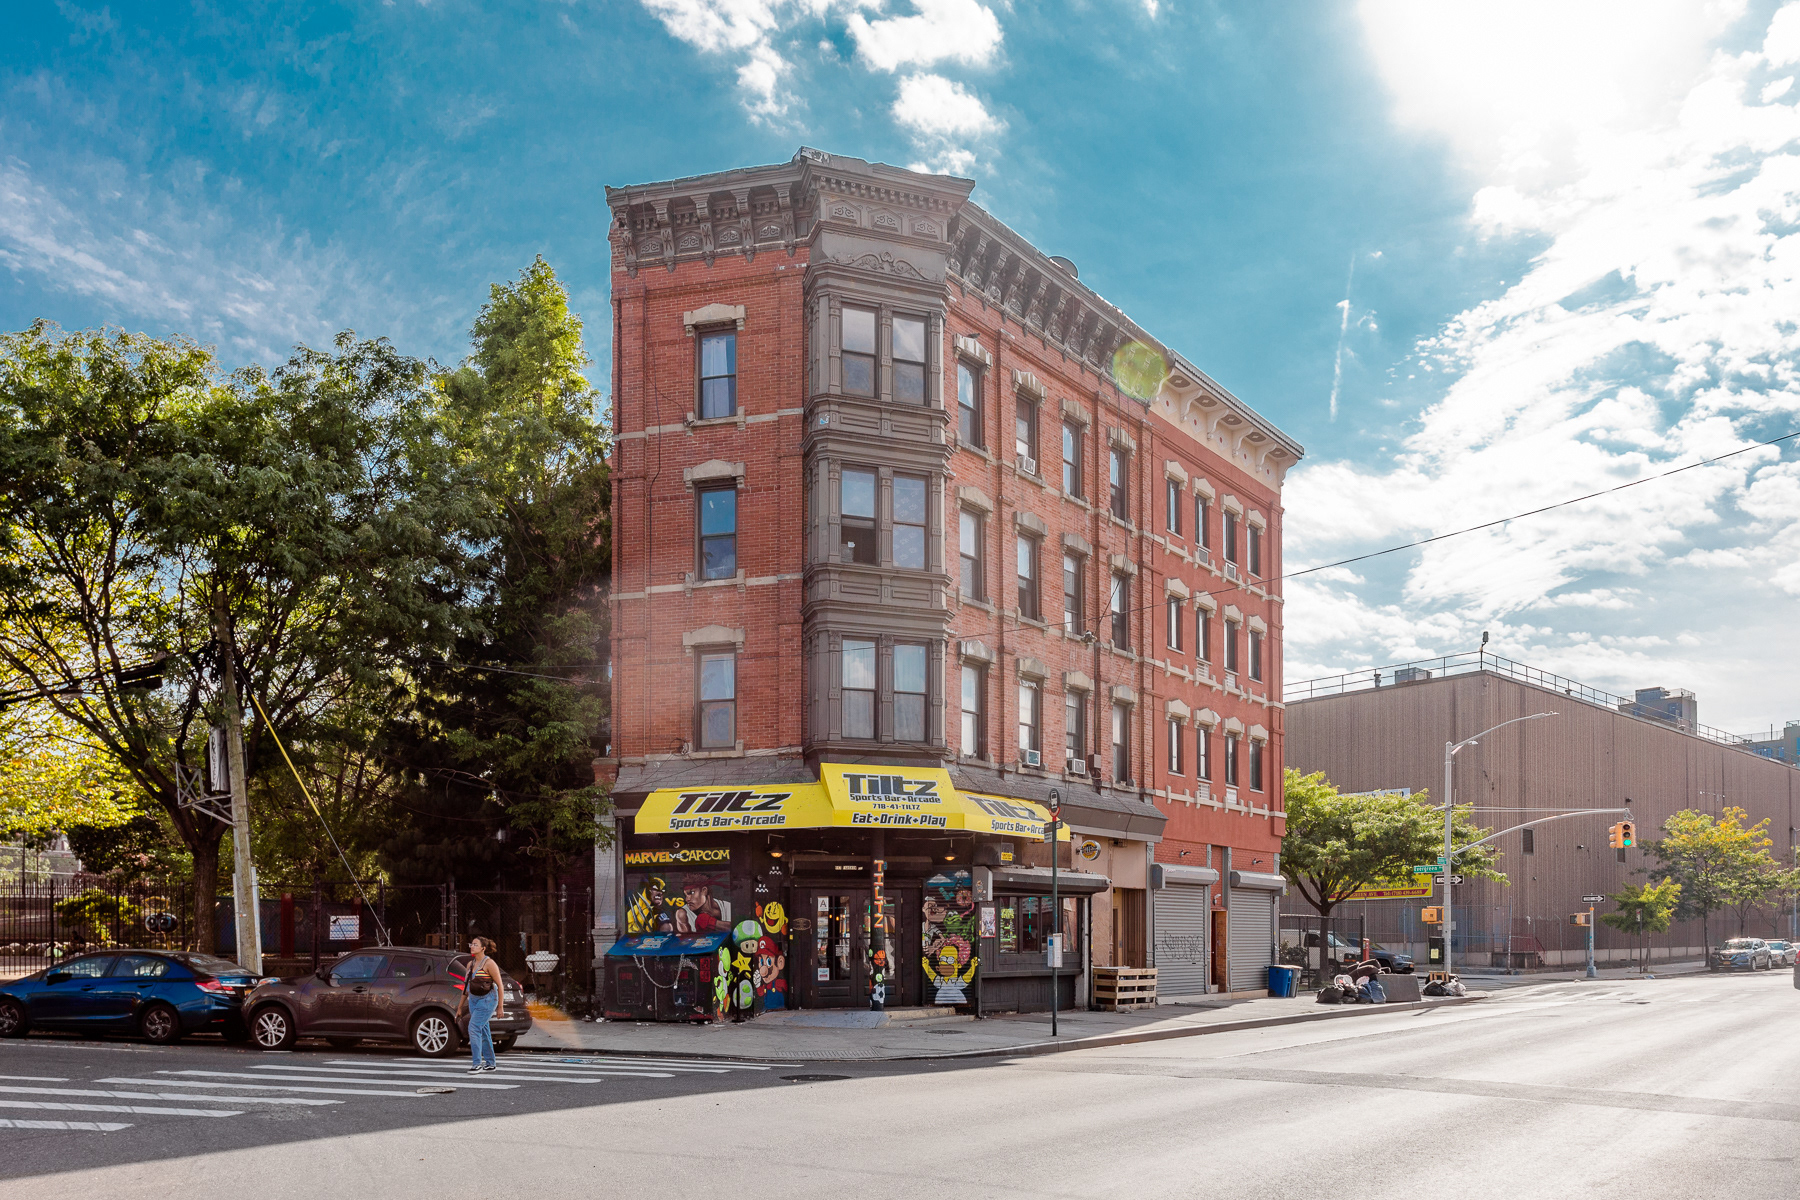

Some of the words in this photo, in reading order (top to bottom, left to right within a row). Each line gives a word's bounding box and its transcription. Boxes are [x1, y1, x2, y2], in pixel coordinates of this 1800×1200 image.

[842, 772, 938, 797] Tiltz
[671, 790, 793, 815] Tiltz
[849, 793, 882, 802] Sports
[669, 816, 711, 830] Sports
[991, 819, 1014, 831] Sports
[625, 851, 673, 864] MARVEL
[680, 849, 730, 862] CAPCOM
[873, 860, 885, 928] TILTZ
[665, 897, 685, 907] VS
[820, 899, 827, 907] A
